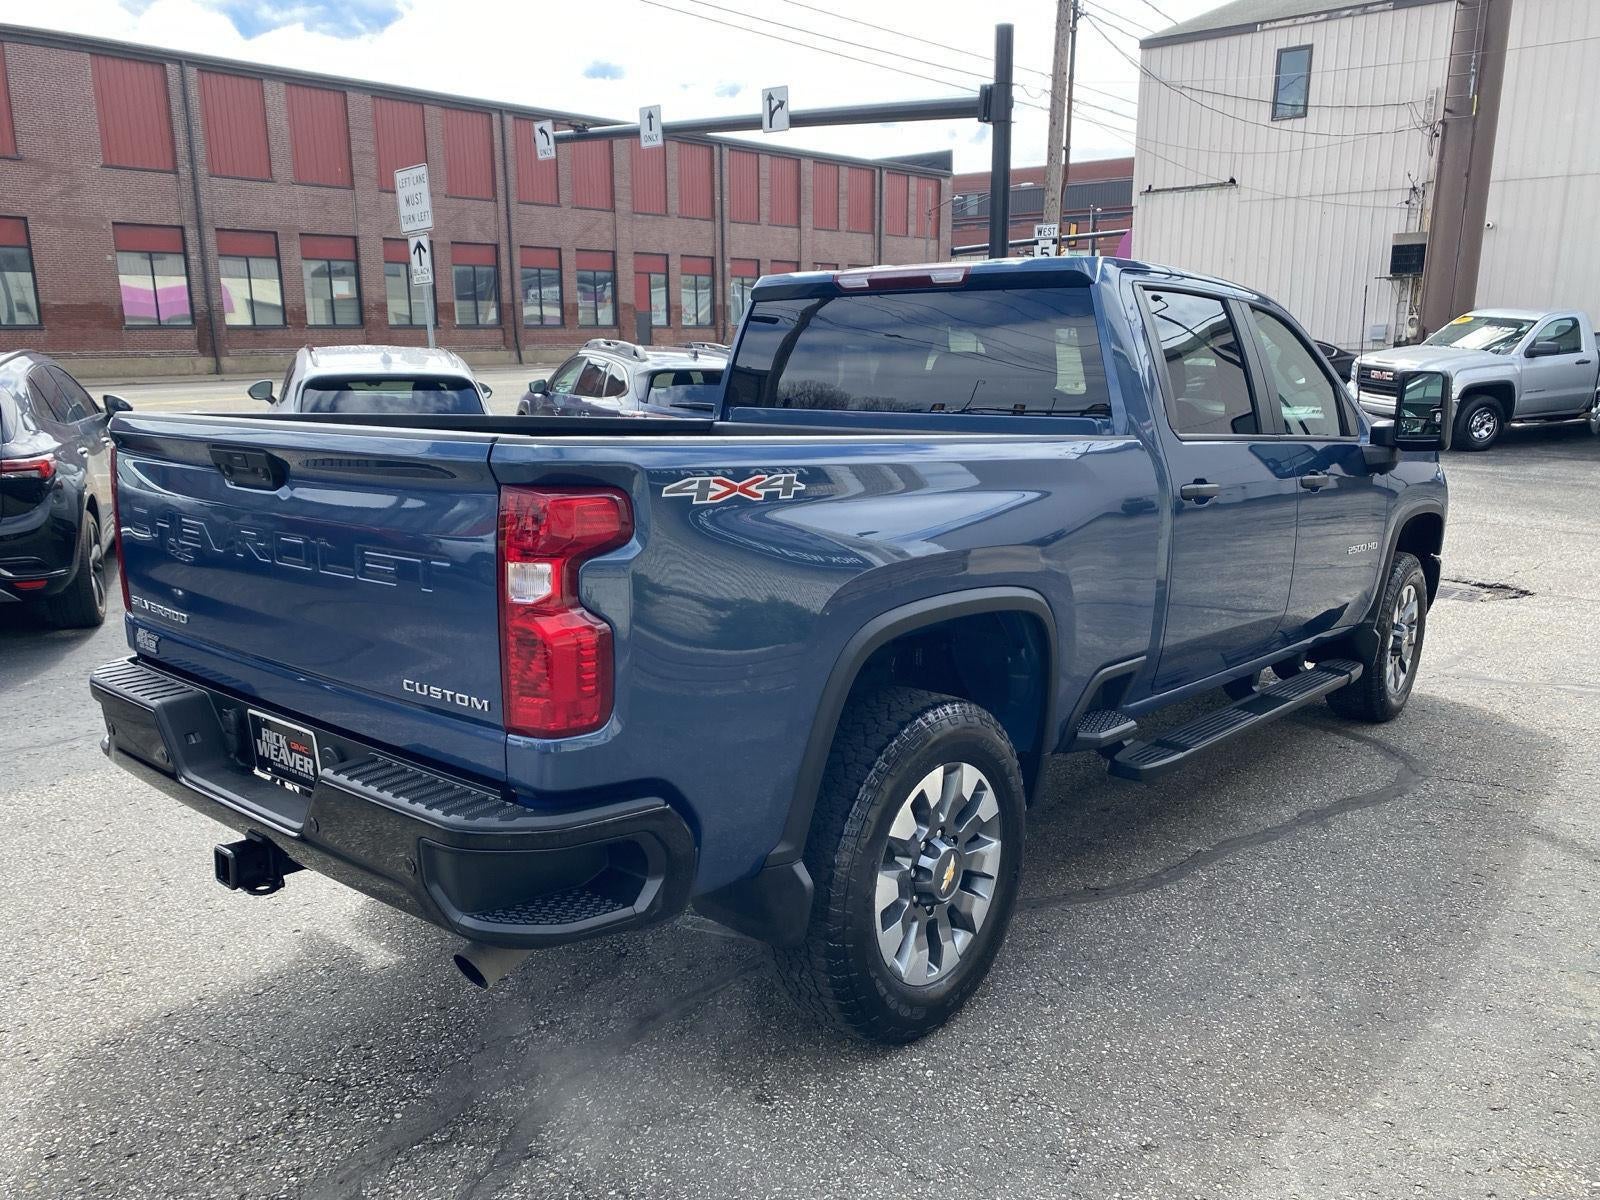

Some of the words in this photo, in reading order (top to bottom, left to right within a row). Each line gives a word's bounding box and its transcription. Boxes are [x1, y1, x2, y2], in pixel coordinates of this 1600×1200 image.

[643, 133, 660, 144] ONLY
[399, 176, 412, 189] LEFT
[412, 173, 426, 186] LANE
[405, 192, 422, 207] MUST
[402, 213, 416, 225] TURN
[417, 211, 430, 223] LEFT
[1037, 227, 1056, 237] WEST
[1041, 247, 1050, 257] 5
[1370, 370, 1393, 380] GMC
[1347, 543, 1367, 555] 2500
[1367, 541, 1378, 551] HD
[131, 595, 189, 624] SILVERADO
[402, 678, 489, 712] CUSTOM
[261, 727, 287, 748] RICK
[290, 742, 310, 754] GMC
[256, 739, 314, 776] WEAVER
